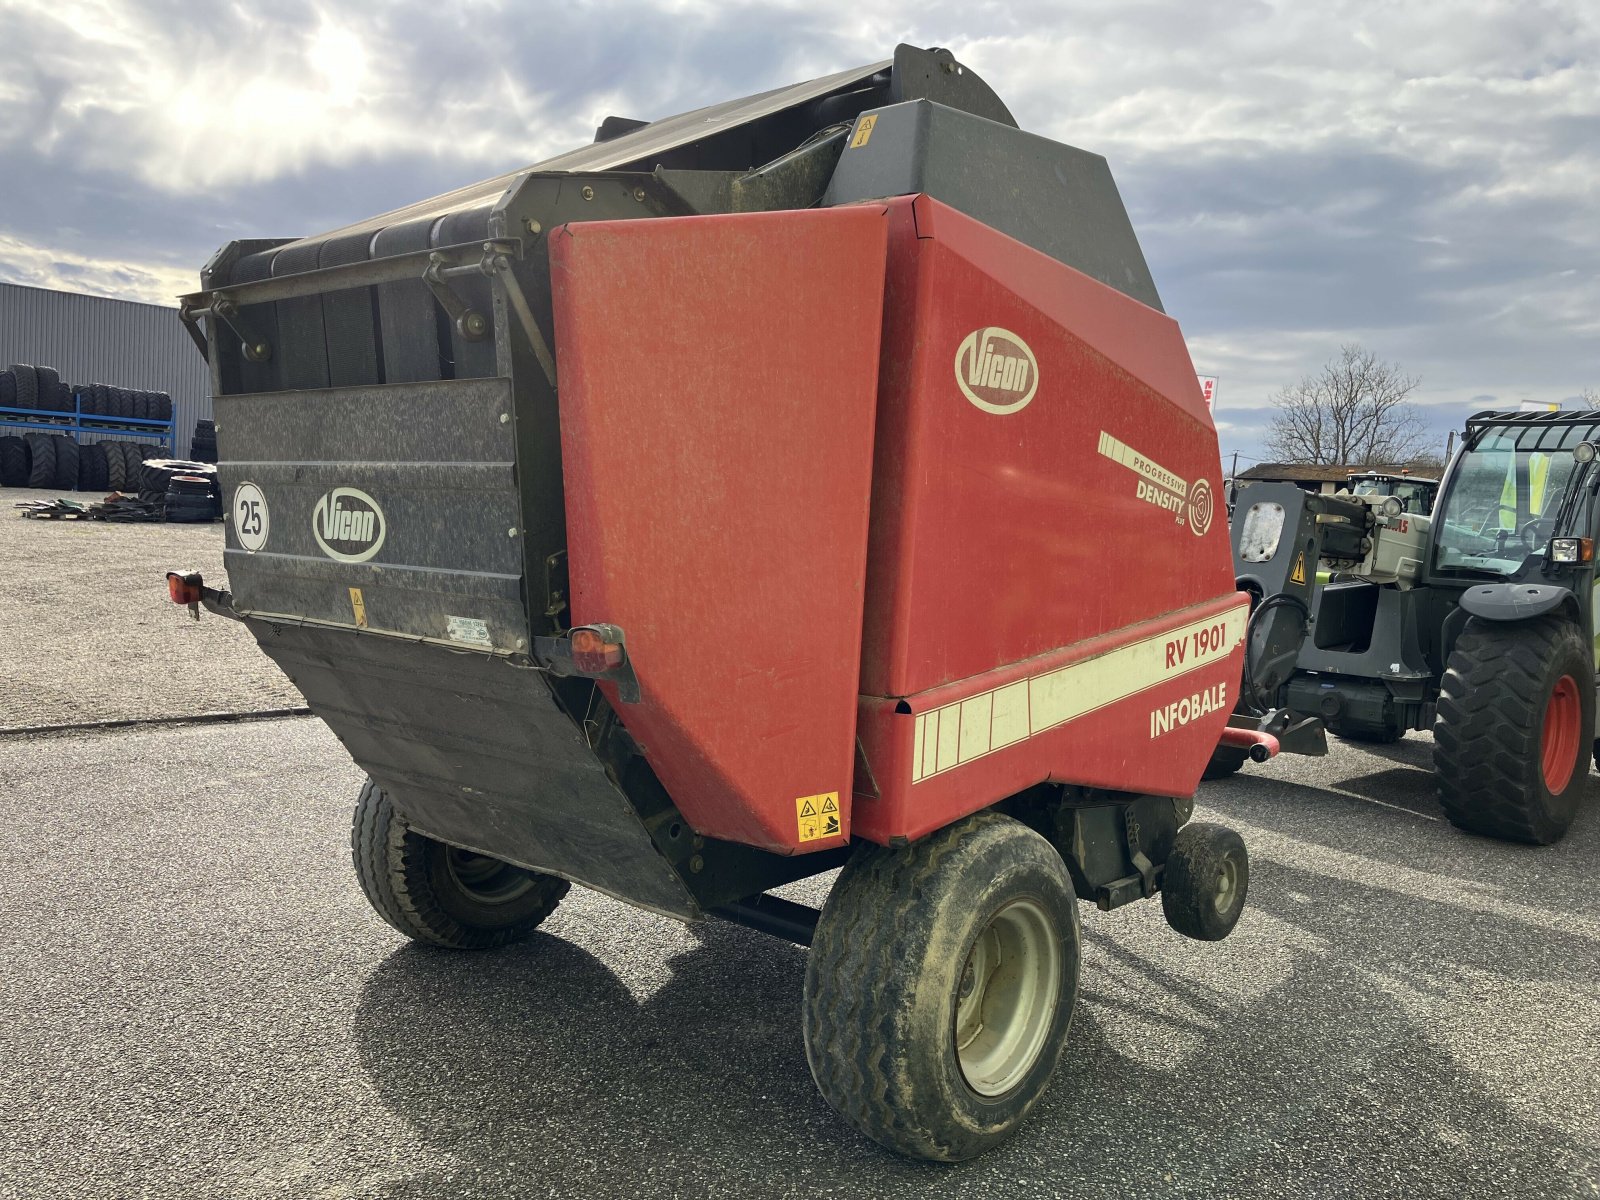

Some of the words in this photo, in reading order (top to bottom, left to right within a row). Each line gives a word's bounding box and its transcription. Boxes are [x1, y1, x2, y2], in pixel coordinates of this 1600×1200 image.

[968, 331, 1029, 392] Vicon
[1133, 456, 1186, 493] PROGRESSIVE
[1136, 480, 1186, 514] DENSITY
[240, 500, 262, 536] 25
[322, 491, 375, 542] Vicon
[1165, 636, 1189, 669] RV
[1193, 622, 1226, 658] 1901
[1150, 682, 1226, 739] INFOBALE
